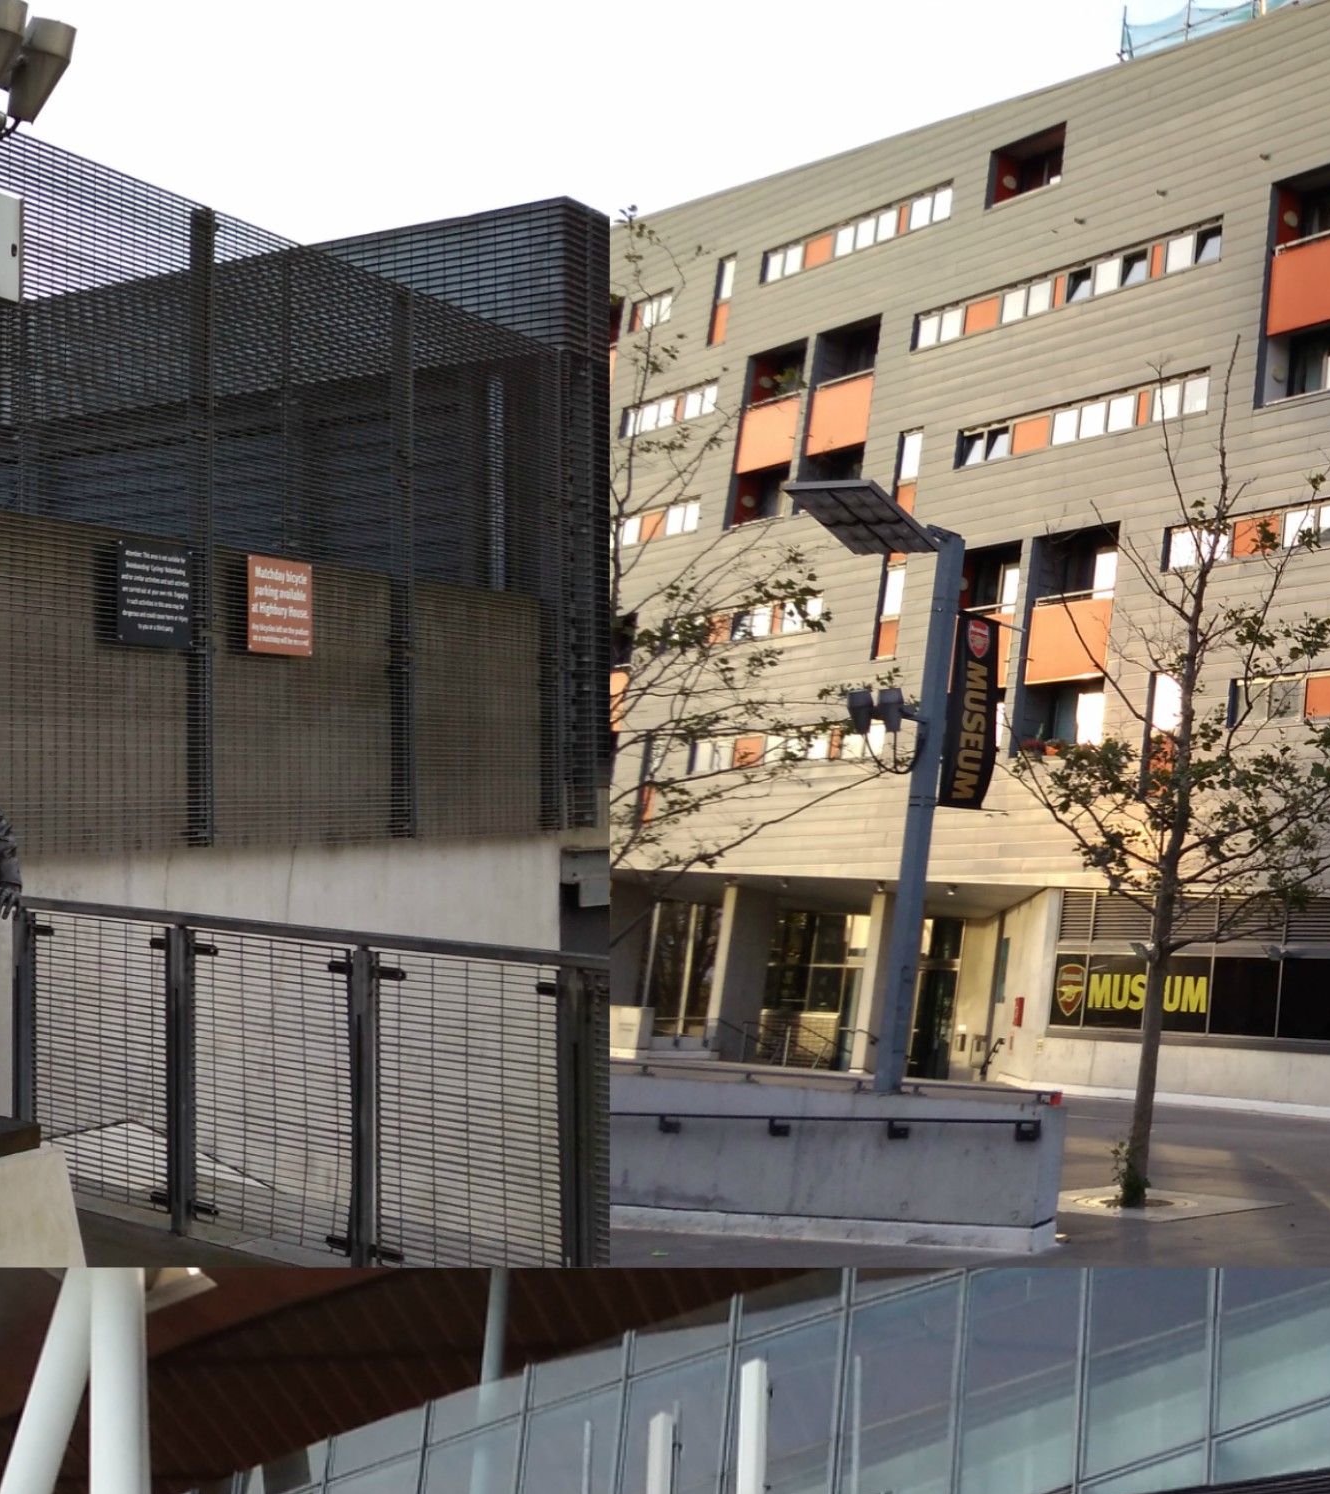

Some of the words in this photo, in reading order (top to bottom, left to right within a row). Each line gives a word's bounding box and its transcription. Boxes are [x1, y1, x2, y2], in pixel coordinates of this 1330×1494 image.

[255, 566, 285, 584] Matchday
[286, 571, 307, 586] bicycle
[254, 585, 278, 600] parking
[279, 589, 306, 601] available
[252, 602, 258, 612] at
[260, 602, 287, 619] Highbury
[289, 606, 309, 618] House.
[951, 660, 988, 799] MUSEUM
[1088, 973, 1207, 1013] MUSUM
